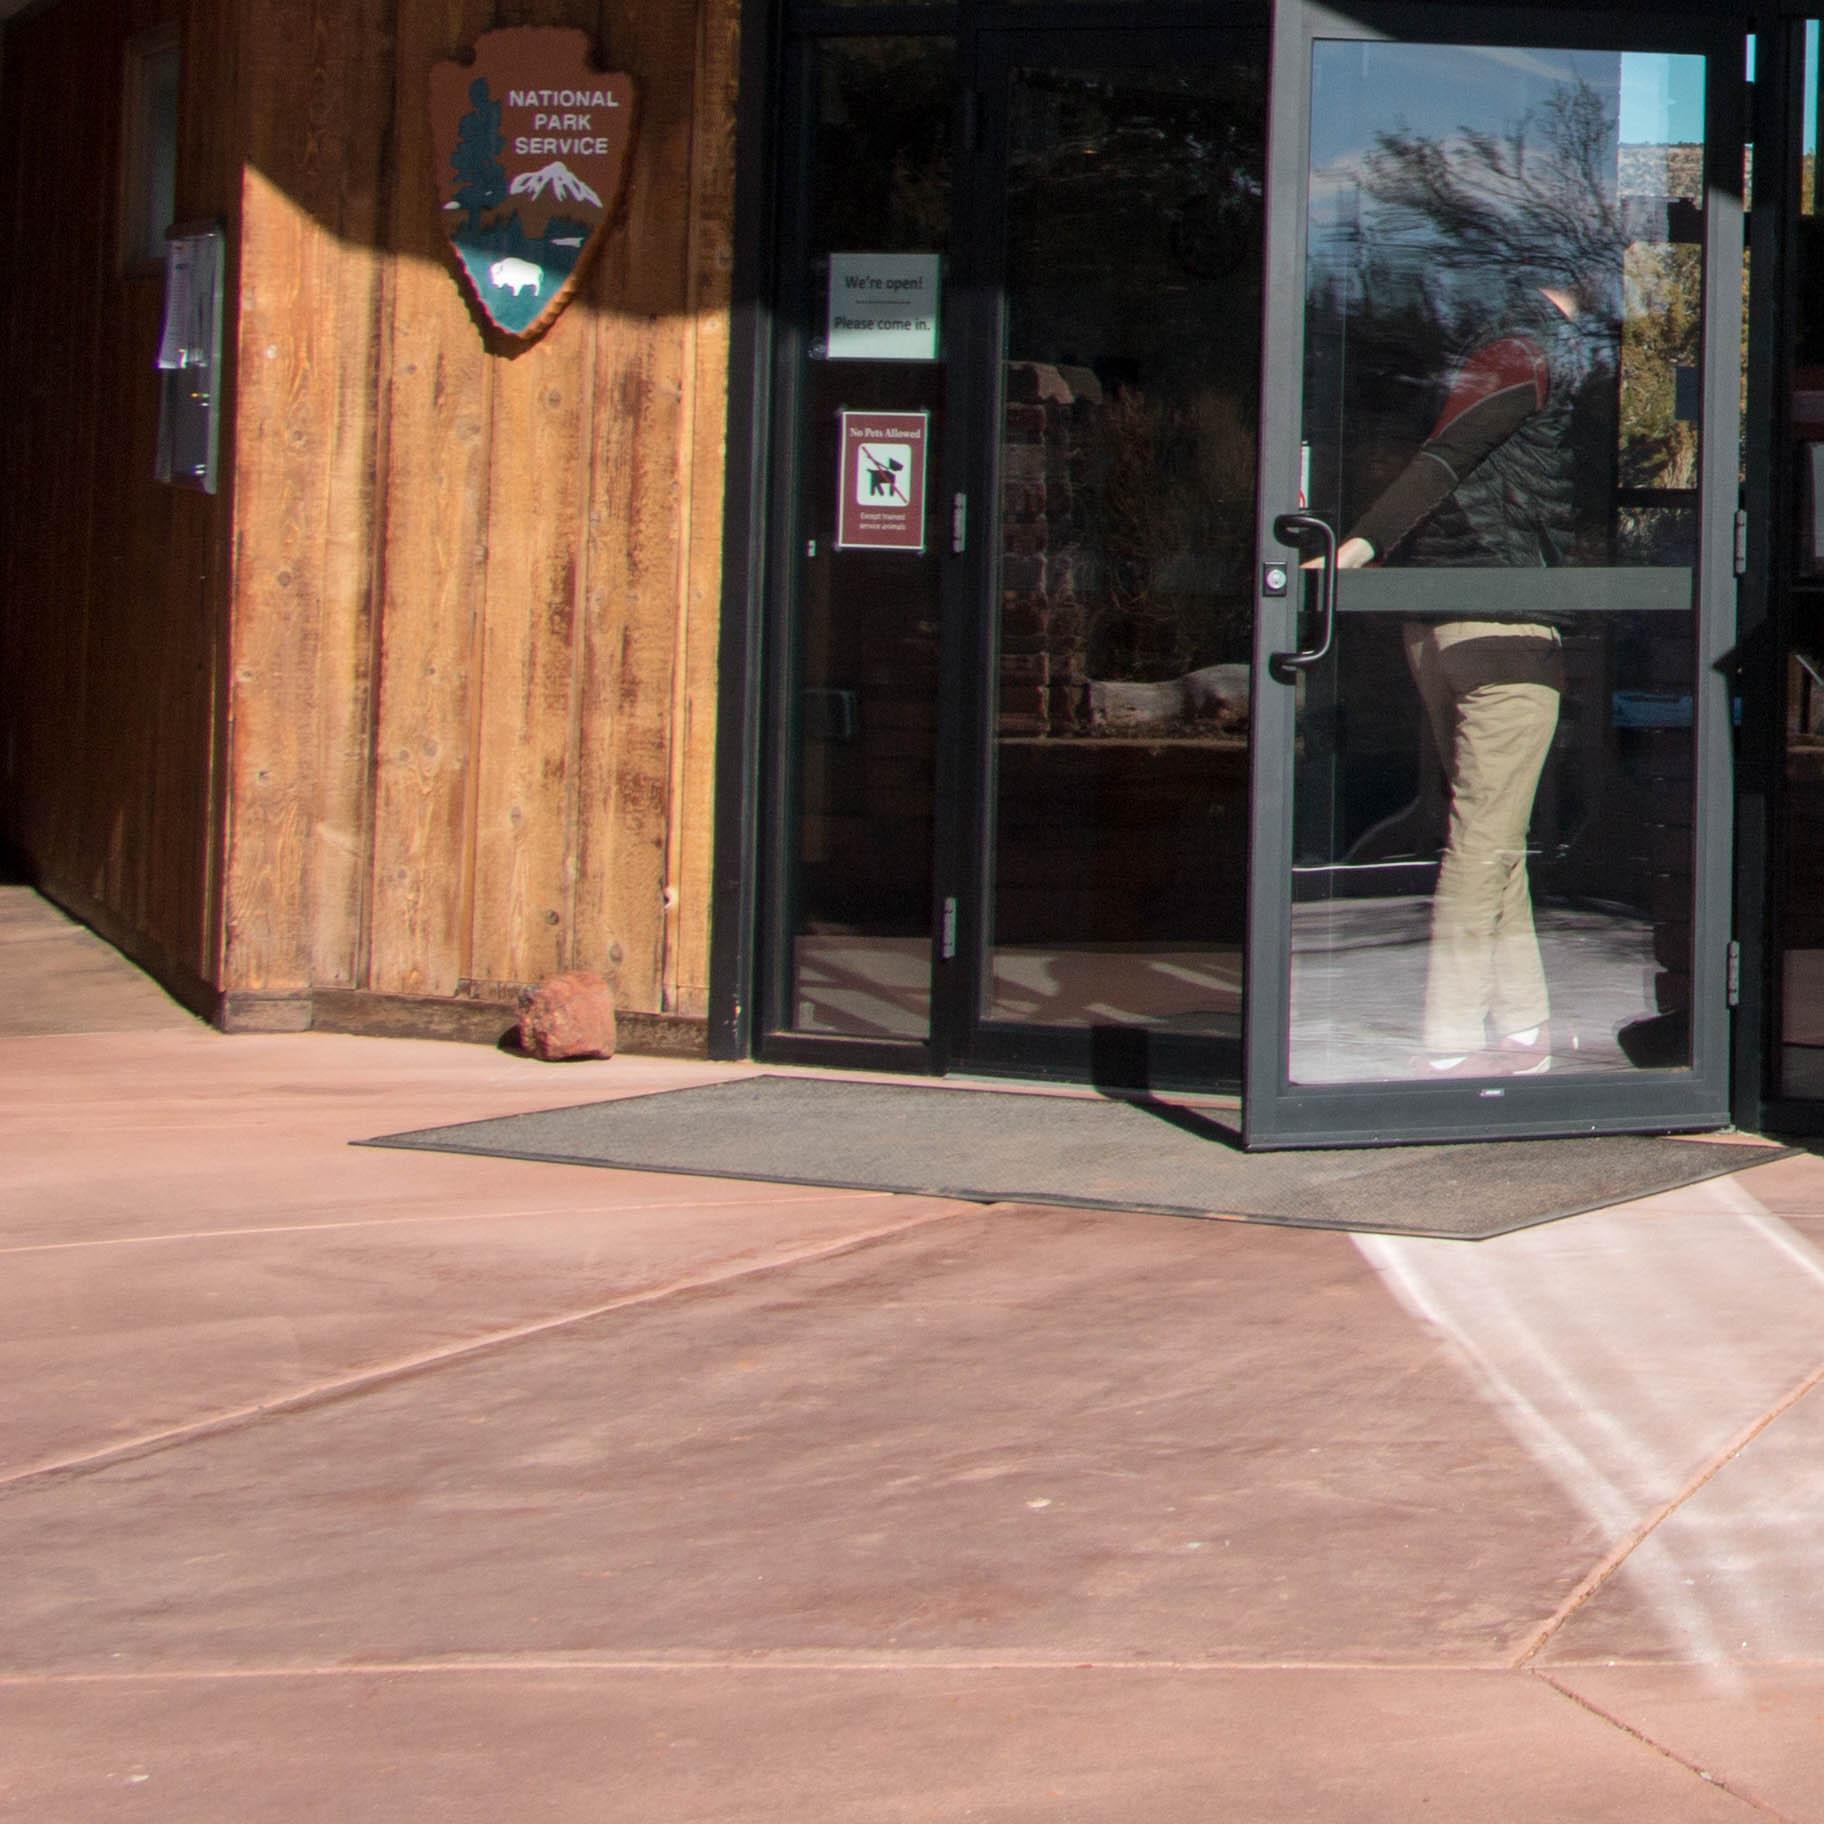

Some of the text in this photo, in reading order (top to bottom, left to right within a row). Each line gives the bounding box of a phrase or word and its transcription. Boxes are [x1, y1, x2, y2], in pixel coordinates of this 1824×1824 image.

[509, 90, 619, 107] NATIONAL
[534, 114, 592, 130] PARK
[515, 137, 608, 155] SERVICE
[845, 275, 923, 292] We're open!
[834, 316, 931, 330] Please come in.
[850, 427, 921, 438] No Pets Allowed
